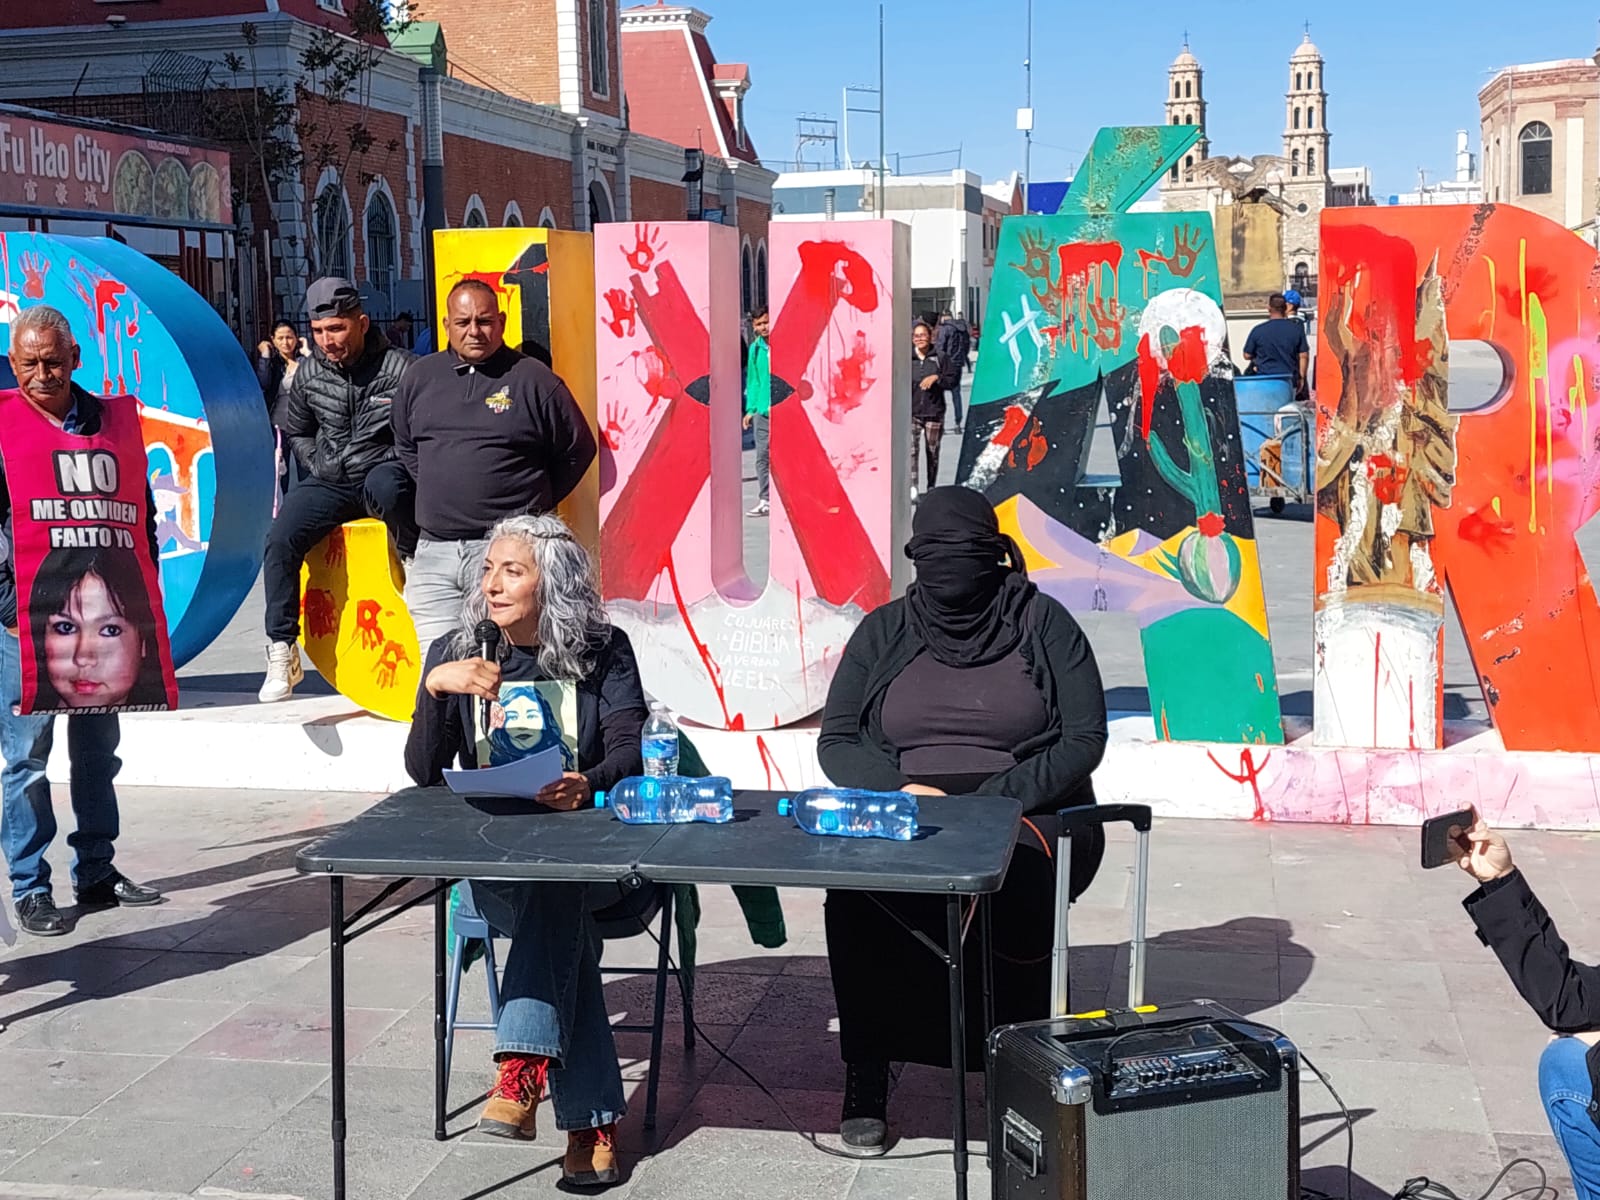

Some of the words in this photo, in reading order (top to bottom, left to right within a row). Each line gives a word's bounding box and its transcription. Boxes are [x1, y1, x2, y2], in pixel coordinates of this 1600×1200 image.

[0, 123, 25, 175] Fu
[30, 127, 69, 179] Hao
[74, 133, 111, 194] City
[57, 452, 117, 493] NO
[32, 499, 66, 520] ME
[70, 499, 137, 524] OLVIDEN
[50, 527, 111, 548] FALTO
[115, 528, 134, 549] YO
[729, 630, 791, 655] BIBLIA
